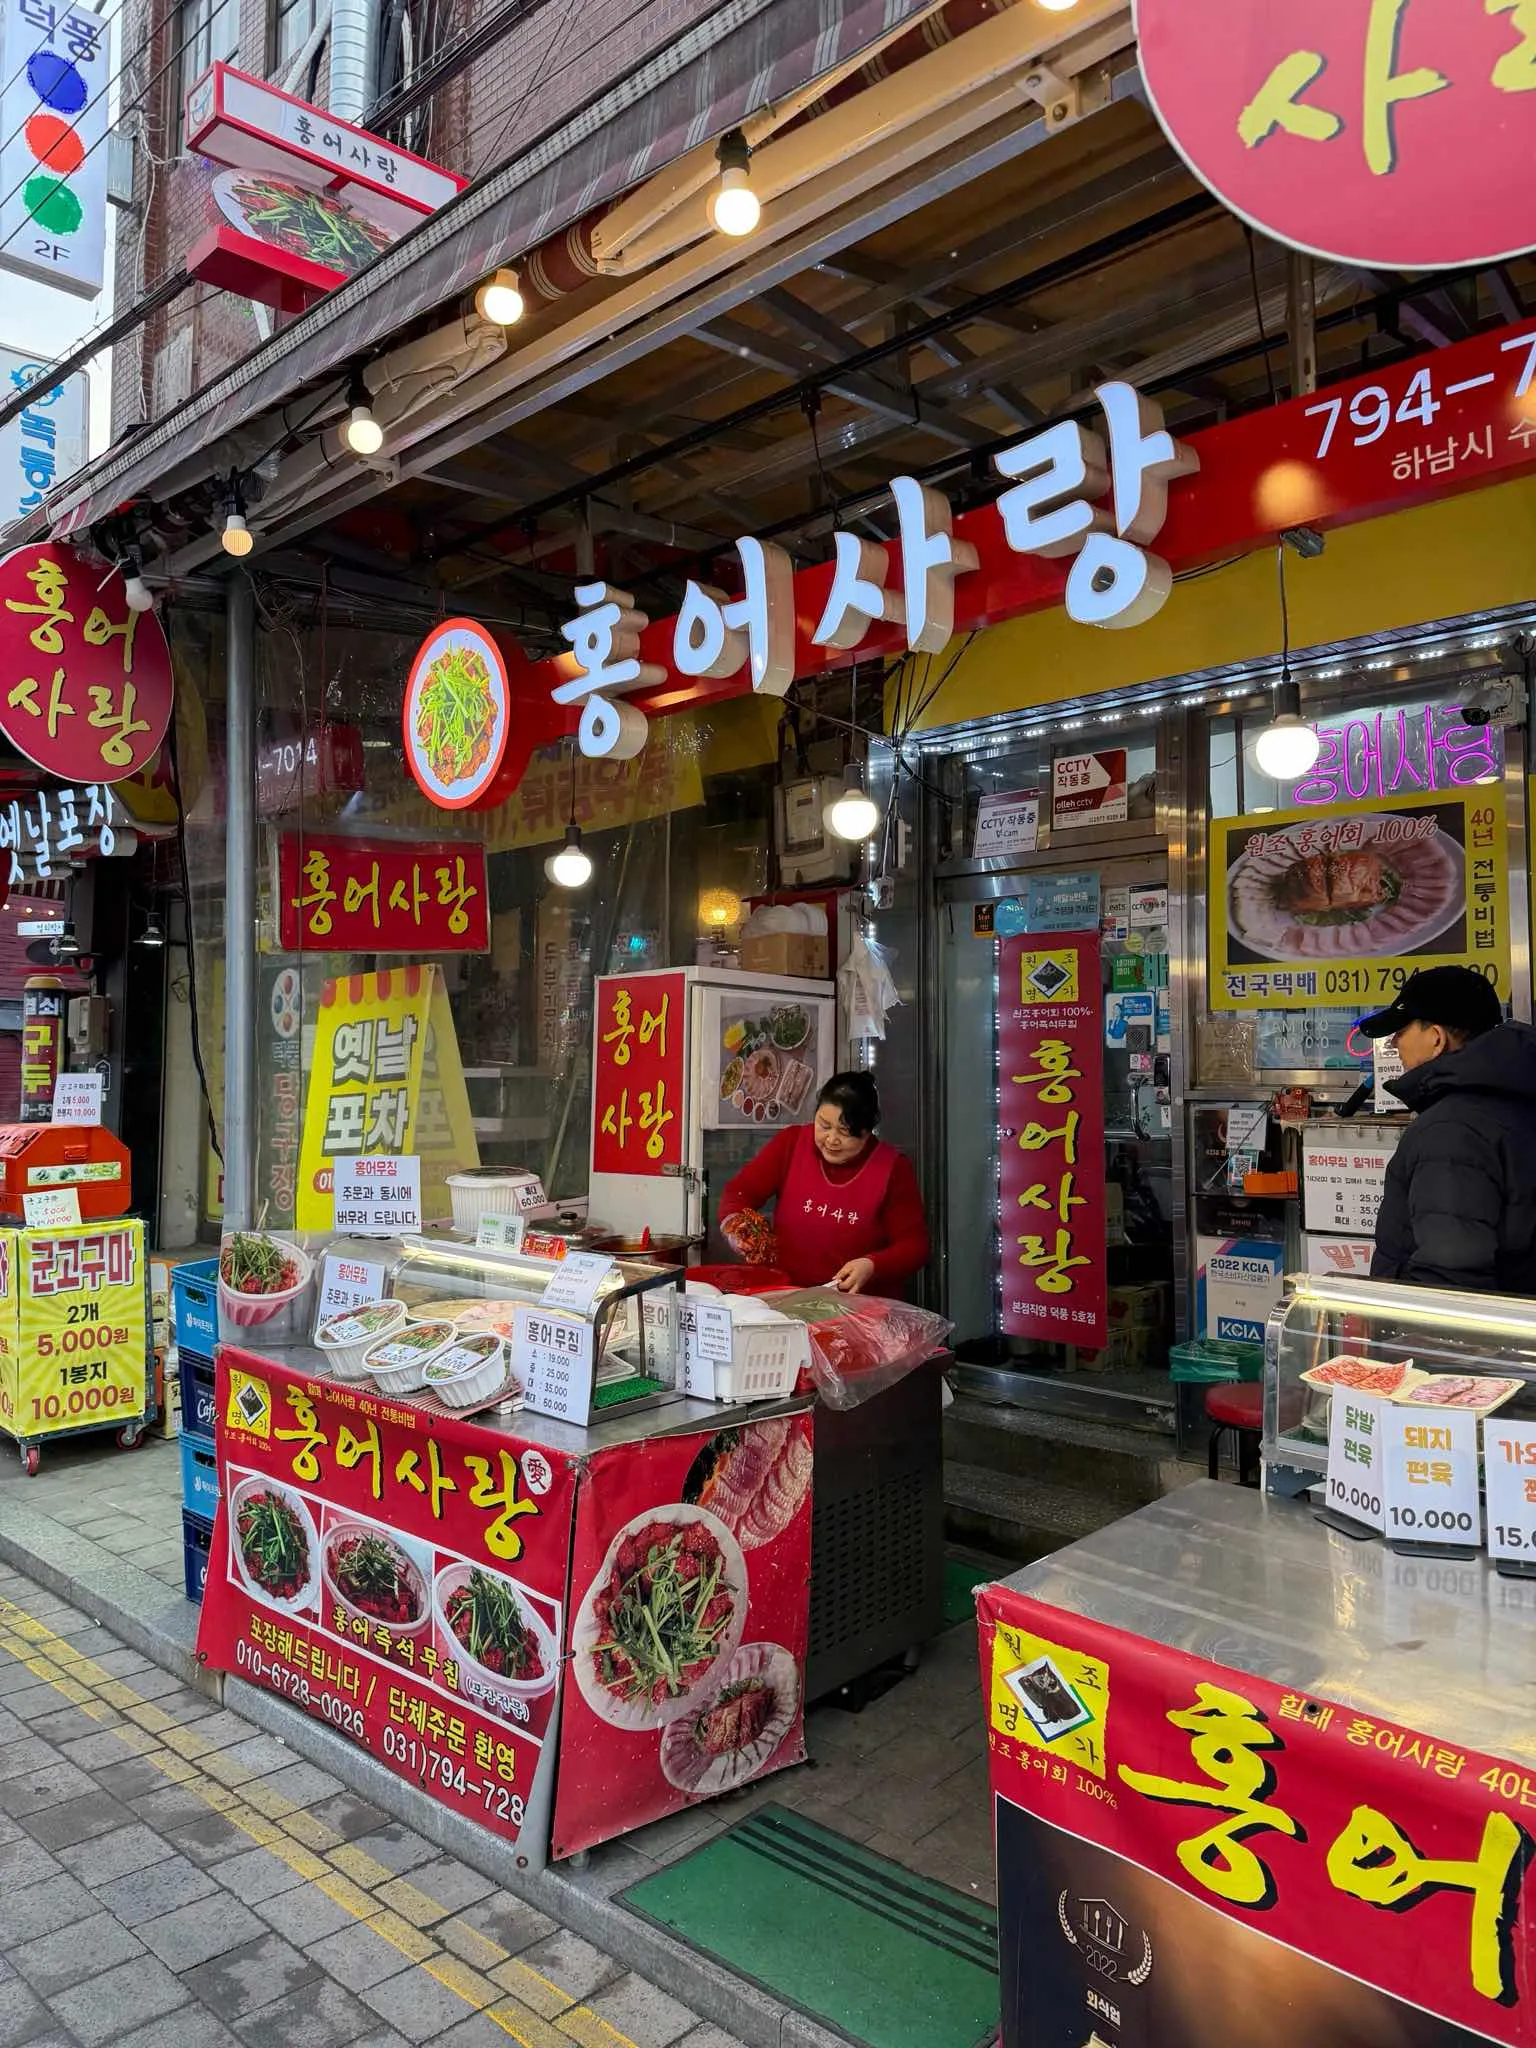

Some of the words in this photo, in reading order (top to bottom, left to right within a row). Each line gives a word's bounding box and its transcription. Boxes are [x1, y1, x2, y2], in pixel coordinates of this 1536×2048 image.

[294, 115, 398, 183] 홍어사랑
[34, 240, 70, 262] 2F
[1391, 425, 1493, 480] 하남시
[551, 381, 1178, 760] 홍어사랑
[6, 558, 140, 673] 홍어
[8, 667, 151, 766] 사랑
[1057, 758, 1092, 774] CCTV
[1057, 773, 1091, 787] 작동중
[981, 817, 1004, 831] CCTV
[1007, 812, 1037, 827] 작동중
[1056, 799, 1076, 810] olleh
[1076, 797, 1094, 808] cctv
[1246, 833, 1289, 858] 원조
[1297, 821, 1365, 853] 홍어회
[1374, 814, 1438, 843] 100%
[291, 850, 477, 935] 홍어사랑
[1226, 970, 1317, 999] 전국택배
[1325, 967, 1370, 992] 031)
[603, 990, 668, 1065] 홍어
[332, 1017, 416, 1088] 옛날
[322, 1087, 410, 1158] 포차
[601, 1079, 674, 1159] 사랑
[1012, 1039, 1092, 1294] 홍어사랑
[343, 1186, 374, 1200] 주문과
[380, 1186, 412, 1200] 동시에
[803, 1198, 859, 1225] 홍어사랑
[337, 1211, 368, 1225] 버무려
[31, 1231, 135, 1297] 군고구마
[1210, 1258, 1240, 1272] 2022
[67, 1302, 99, 1325] 2개
[37, 1325, 129, 1358] 5,000원
[528, 1320, 579, 1353] 홍어무침
[60, 1361, 107, 1386] 1봉지
[31, 1384, 135, 1421] 10,000원
[380, 1405, 417, 1429] 전통비법
[1343, 1437, 1373, 1469] 편육
[1403, 1426, 1453, 1451] 돼지
[274, 1384, 541, 1562] 홍어사랑
[1406, 1460, 1454, 1487] 편육
[1329, 1478, 1381, 1516] 10,000
[1389, 1507, 1473, 1532] 10,000
[333, 1604, 460, 1691] 홍어즉석무침
[1002, 1632, 1022, 1660] 원
[1075, 1664, 1102, 1690] 조
[250, 1614, 361, 1700] 포장해드립니다
[388, 1686, 467, 1757] 단체주문
[474, 1729, 516, 1783] 환영
[998, 1702, 1019, 1732] 명
[1075, 1736, 1100, 1766] 가
[1346, 1718, 1467, 1779] 홍어사랑
[1117, 1682, 1512, 2000] 홍어
